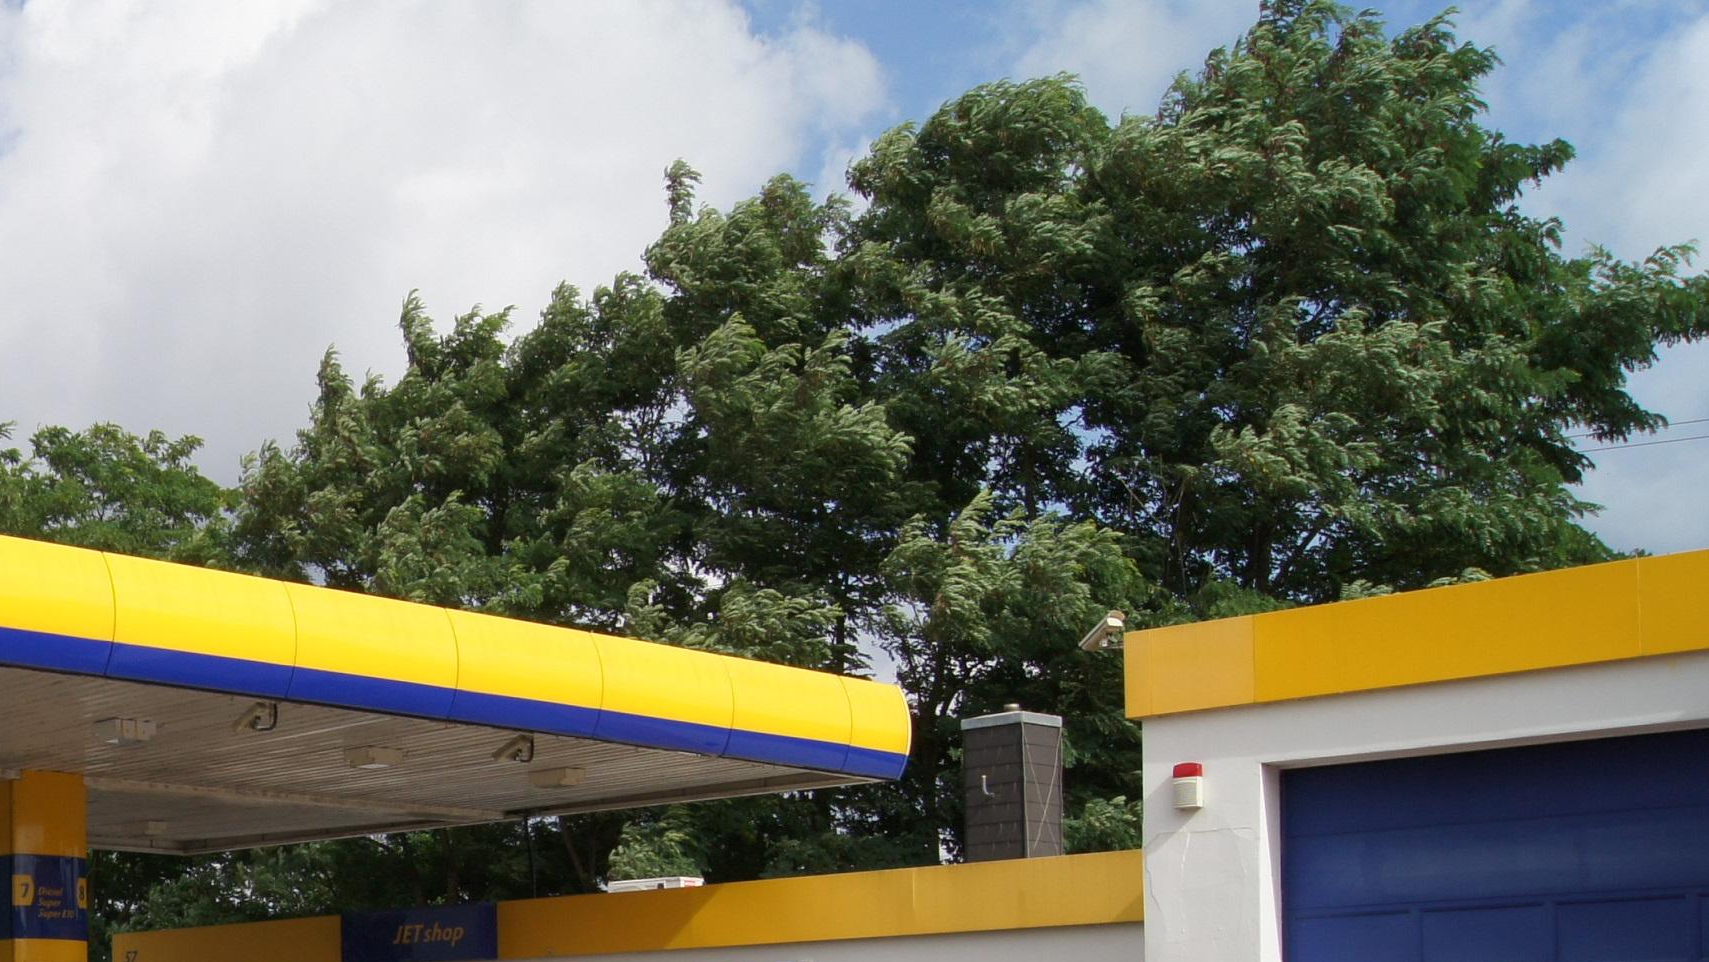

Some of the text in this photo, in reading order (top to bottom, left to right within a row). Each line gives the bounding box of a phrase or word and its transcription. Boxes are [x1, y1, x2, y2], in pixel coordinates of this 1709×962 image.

[21, 883, 29, 898] 7
[393, 921, 464, 947] JET shop
